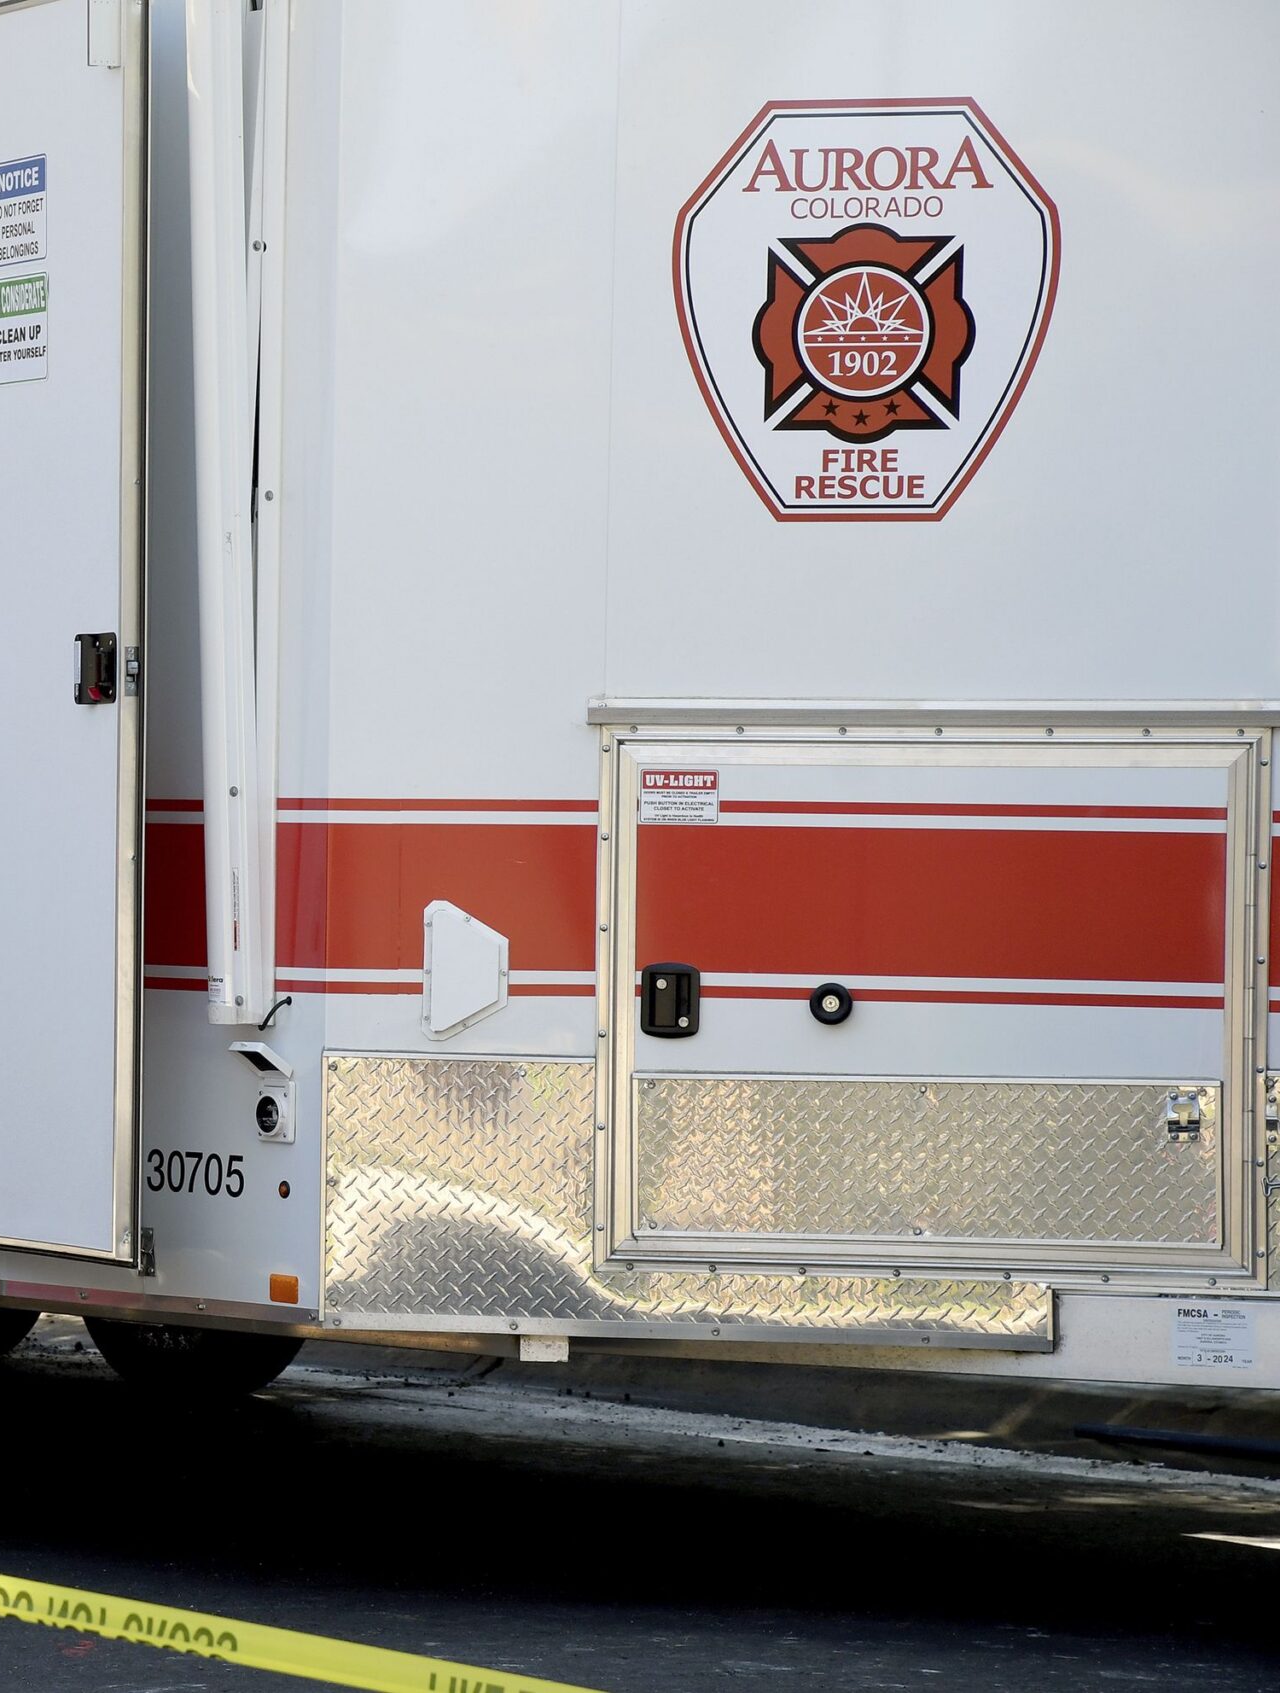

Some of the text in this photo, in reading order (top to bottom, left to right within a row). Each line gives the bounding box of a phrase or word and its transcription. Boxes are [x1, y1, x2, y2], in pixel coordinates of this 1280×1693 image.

[742, 135, 994, 192] AURORA
[4, 202, 17, 218] NOT
[18, 197, 43, 215] FORGET
[790, 195, 944, 219] COLORADO
[1, 221, 35, 240] PERSONAL
[1, 280, 45, 313] CONSIDERATE
[28, 324, 41, 341] UP
[13, 345, 47, 361] YOURSELF
[827, 350, 898, 377] 1902
[822, 448, 899, 473] FIRE
[794, 475, 925, 499] RESCUE
[645, 774, 715, 787] UV-LIGHT
[146, 1148, 245, 1198] 30705
[1177, 1308, 1209, 1319] FMCSA
[1197, 1353, 1202, 1362] 3
[1212, 1355, 1234, 1363] 2024
